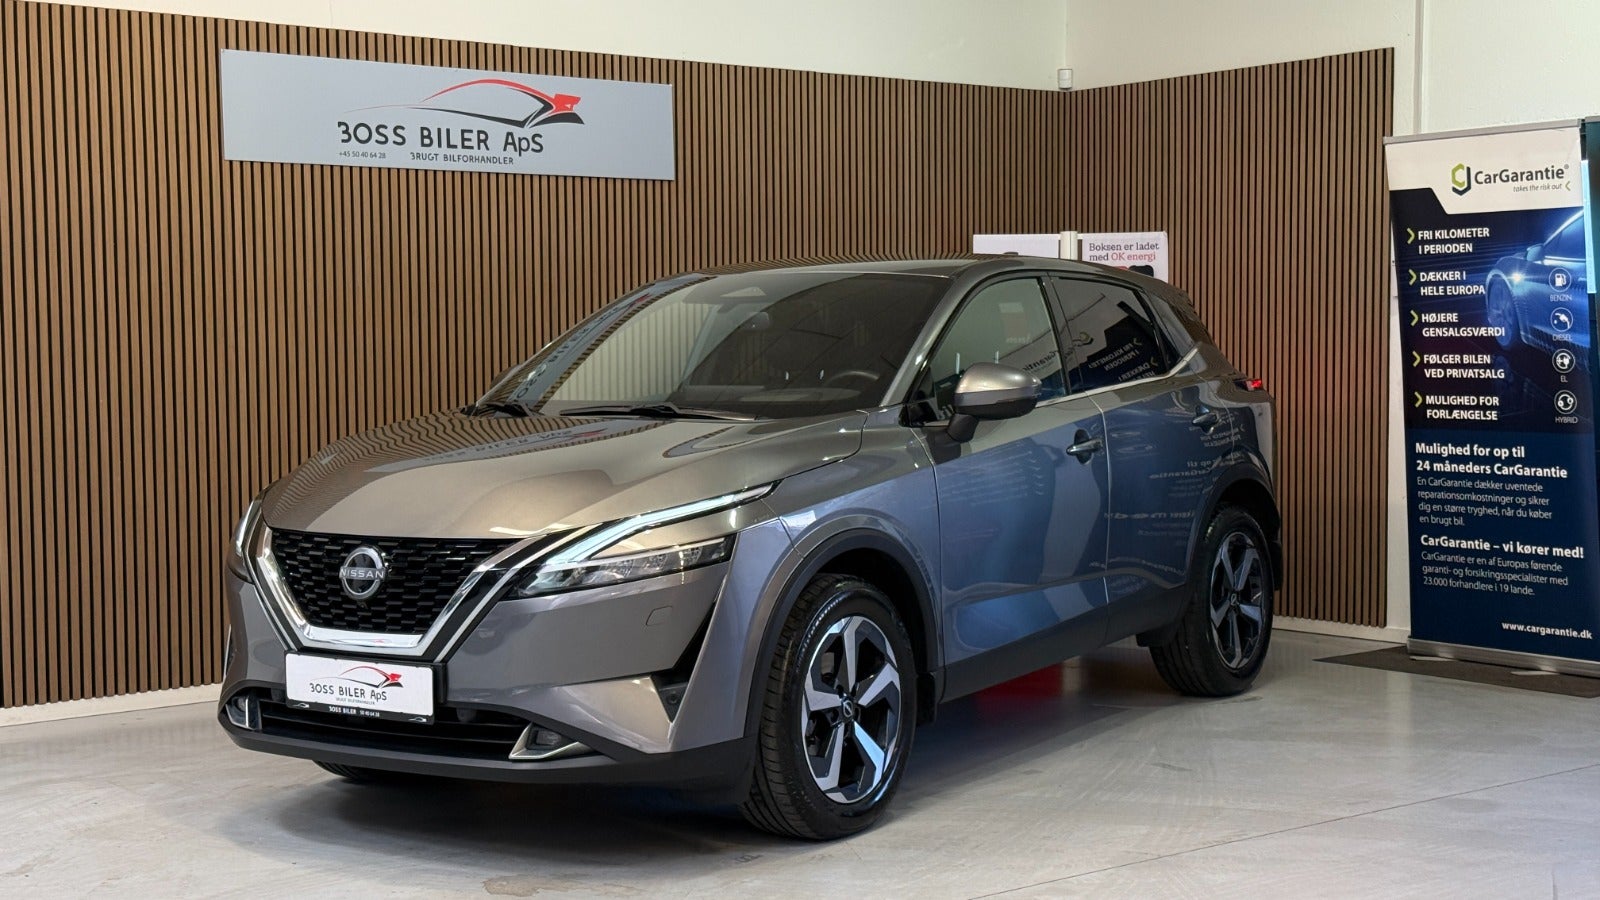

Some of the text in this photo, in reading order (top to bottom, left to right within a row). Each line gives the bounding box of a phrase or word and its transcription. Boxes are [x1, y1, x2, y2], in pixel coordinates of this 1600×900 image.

[420, 126, 490, 150] BILER
[503, 132, 544, 157] ApS
[443, 155, 514, 165] BILFORHANDLER
[1418, 228, 1489, 240] FRI KILOMETER
[1089, 242, 1122, 252] Boksen
[1136, 242, 1159, 250] ladet
[1419, 243, 1472, 254] I PERIODEN
[1089, 252, 1109, 261] med
[1127, 252, 1156, 262] energi
[1420, 271, 1466, 281] DÆKKER I
[1421, 285, 1485, 296] HELE EUROPA
[1421, 313, 1458, 323] HØJERE
[1422, 327, 1505, 337] GENSALGSVÆRDI
[1424, 355, 1490, 364] FØLGER BILEN
[1424, 369, 1504, 378] VED PRIVATSALG
[1426, 395, 1499, 406] MULIGHED FOR
[1427, 410, 1498, 420] FORLÆNGELSE
[1416, 443, 1525, 459] Mulighed for op til
[1416, 460, 1567, 478] 24 måneders CarGarantie
[1417, 477, 1543, 492] En CarGarantie dækker uventede
[1418, 491, 1549, 506] reparationsomkostninger og sikrer
[1419, 502, 1430, 512] dig
[1444, 504, 1465, 513] større
[1468, 506, 1500, 516] tryghed,
[1502, 507, 1514, 516] når
[1516, 508, 1527, 517] du
[1529, 508, 1552, 519] køber
[1431, 515, 1452, 526] brugt
[1454, 516, 1465, 526] bil.
[1421, 535, 1490, 550] CarGarantie
[1502, 541, 1513, 552] vi
[1517, 542, 1549, 555] kører
[1553, 547, 1584, 558] med!
[1422, 551, 1465, 563] CarGarantie
[1488, 557, 1496, 565] af
[1497, 558, 1529, 569] Europas
[1531, 560, 1562, 572] førende
[340, 569, 384, 578] NISSAN
[1422, 566, 1568, 585] garanti- og forsikringsspecialister med
[1424, 576, 1448, 586] 23.000
[1449, 578, 1493, 591] forhandlere
[1500, 584, 1509, 592] 19
[1511, 585, 1535, 595] lande.
[1502, 622, 1592, 639] www.cargarantie.dk
[339, 686, 365, 698] BILER
[370, 690, 387, 701] ApS
